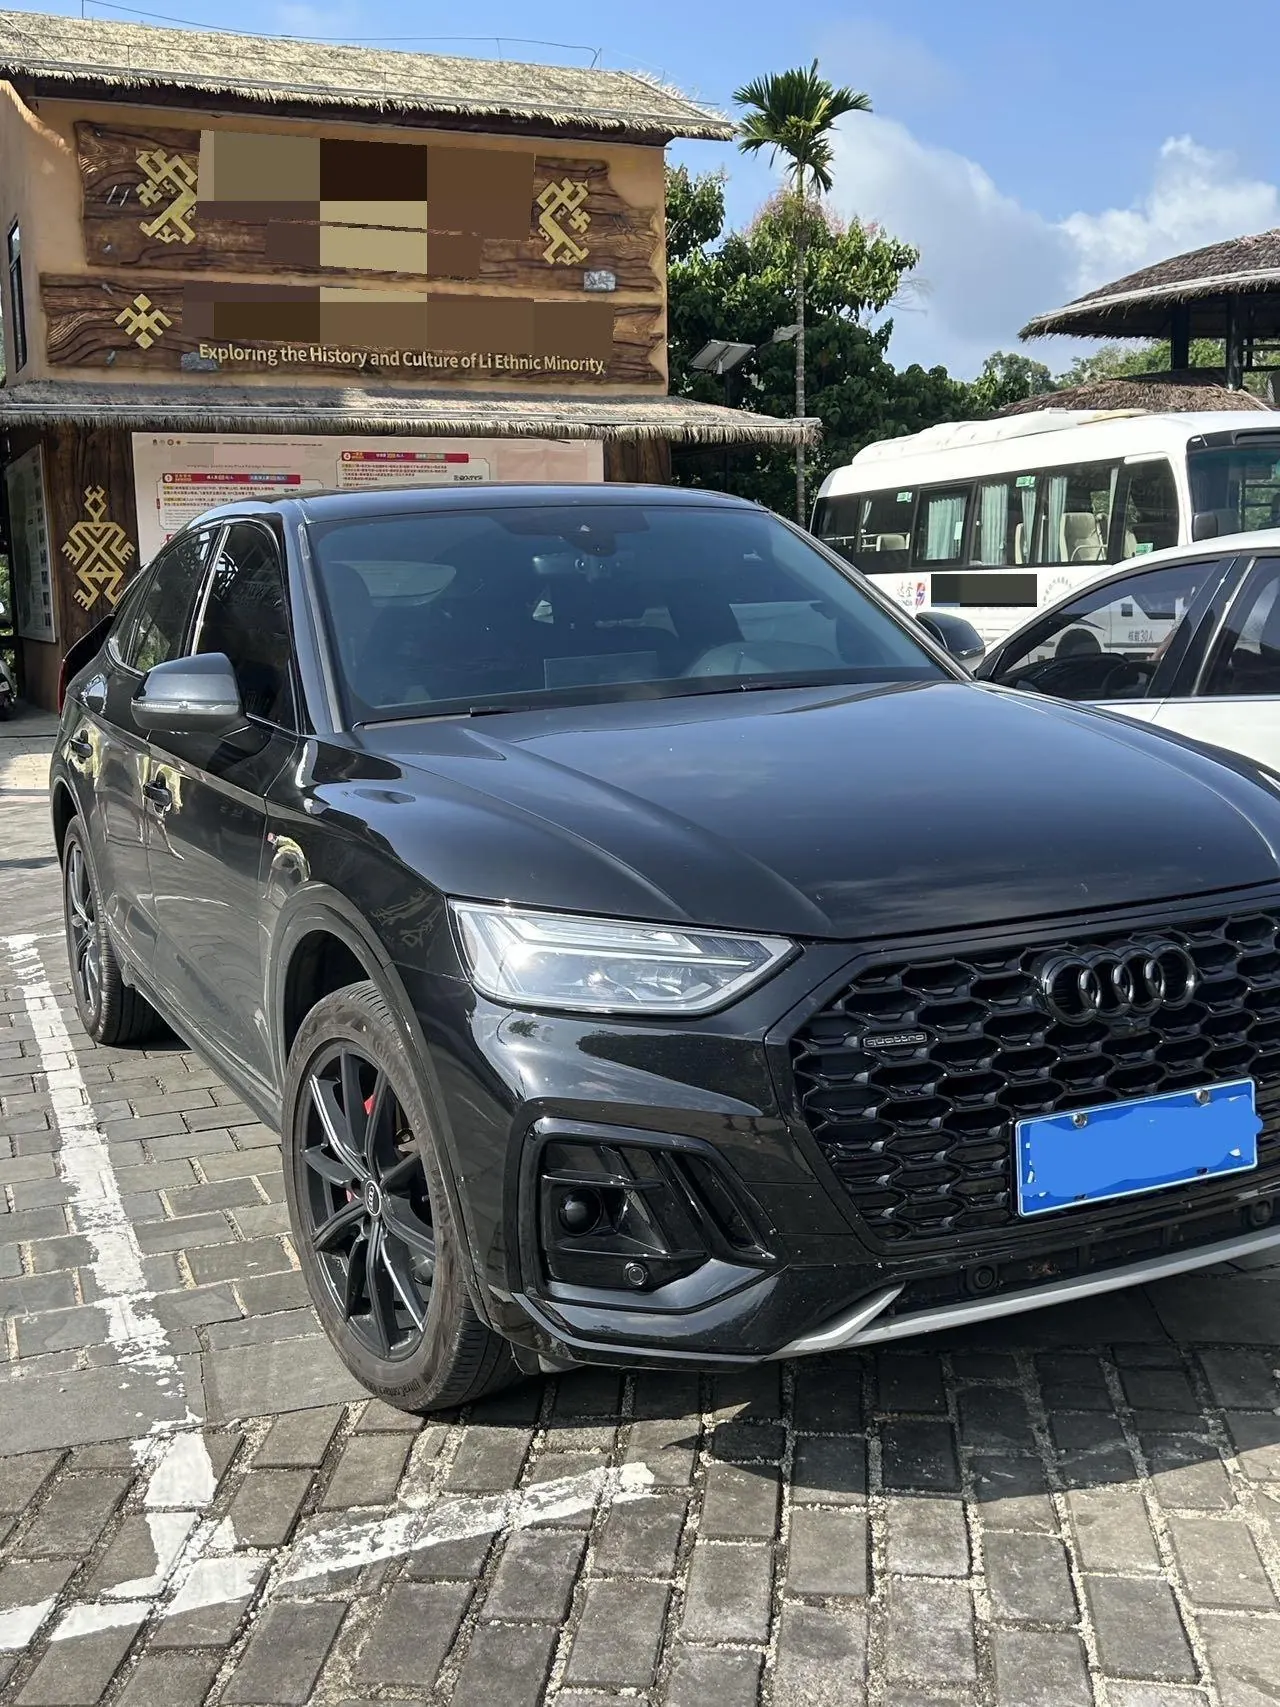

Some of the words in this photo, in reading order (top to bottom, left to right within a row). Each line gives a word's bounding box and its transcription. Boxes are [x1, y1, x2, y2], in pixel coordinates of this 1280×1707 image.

[200, 344, 278, 366] Exploring
[281, 346, 307, 362] the
[310, 347, 368, 367] History
[370, 351, 400, 366] and
[403, 352, 459, 369] Culture
[461, 353, 477, 368] of
[480, 353, 492, 369] Li
[495, 354, 541, 370] Ethnic
[866, 1034, 924, 1046] quattro
